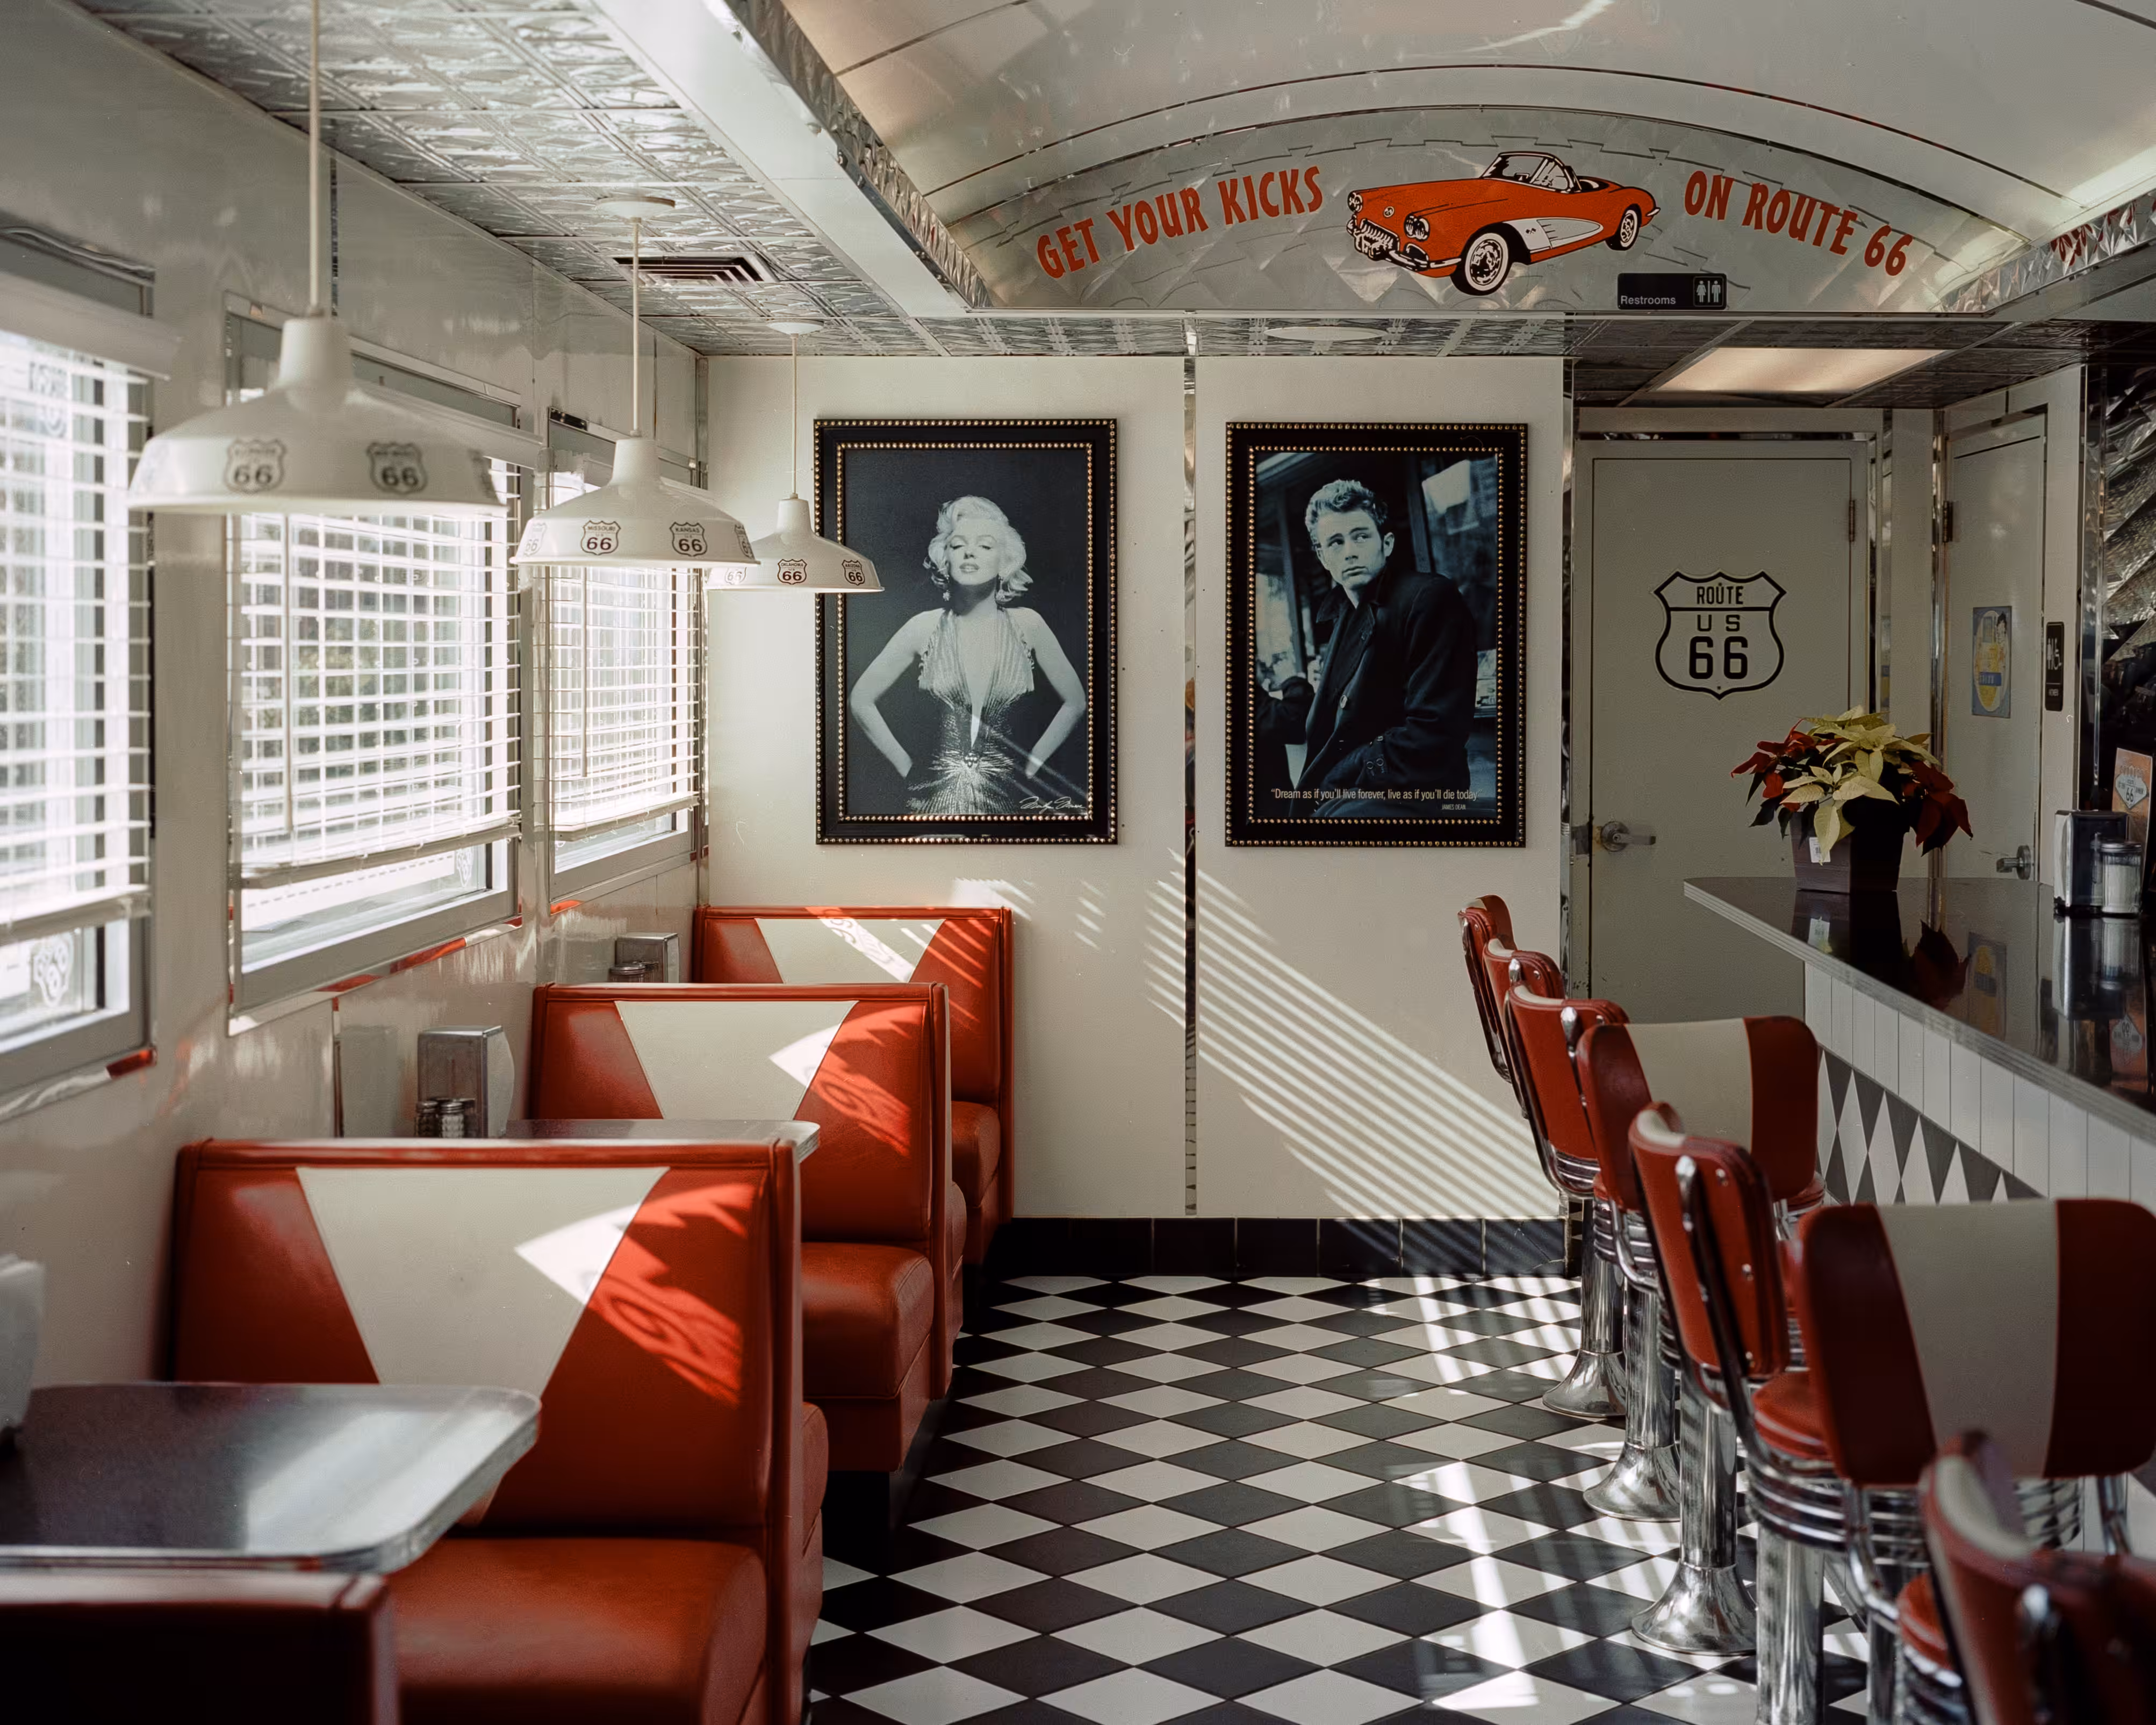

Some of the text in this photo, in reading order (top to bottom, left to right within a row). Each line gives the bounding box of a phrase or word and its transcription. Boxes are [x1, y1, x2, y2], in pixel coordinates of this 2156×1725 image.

[1037, 165, 1324, 279] GET YOUR KICKS
[1684, 170, 1914, 276] ON ROUTE 66
[1620, 295, 1676, 305] Restrooms
[234, 464, 272, 485] 66
[381, 466, 419, 486] 66
[587, 537, 612, 551] 66
[679, 538, 703, 552] 66
[782, 571, 802, 581] 66
[848, 571, 863, 581] 66
[1696, 586, 1743, 605] ROUTE
[1689, 636, 1748, 679] 66
[1303, 790, 1312, 799] as
[1314, 788, 1319, 799] if
[1320, 788, 1341, 801] you’ll
[1343, 788, 1356, 799] live
[1358, 789, 1386, 800] forever,
[1388, 789, 1401, 799] live
[1403, 791, 1412, 799] as
[1414, 789, 1420, 799] if
[1421, 789, 1441, 801] you’ll
[1443, 789, 1455, 799] die
[2126, 787, 2133, 802] 66
